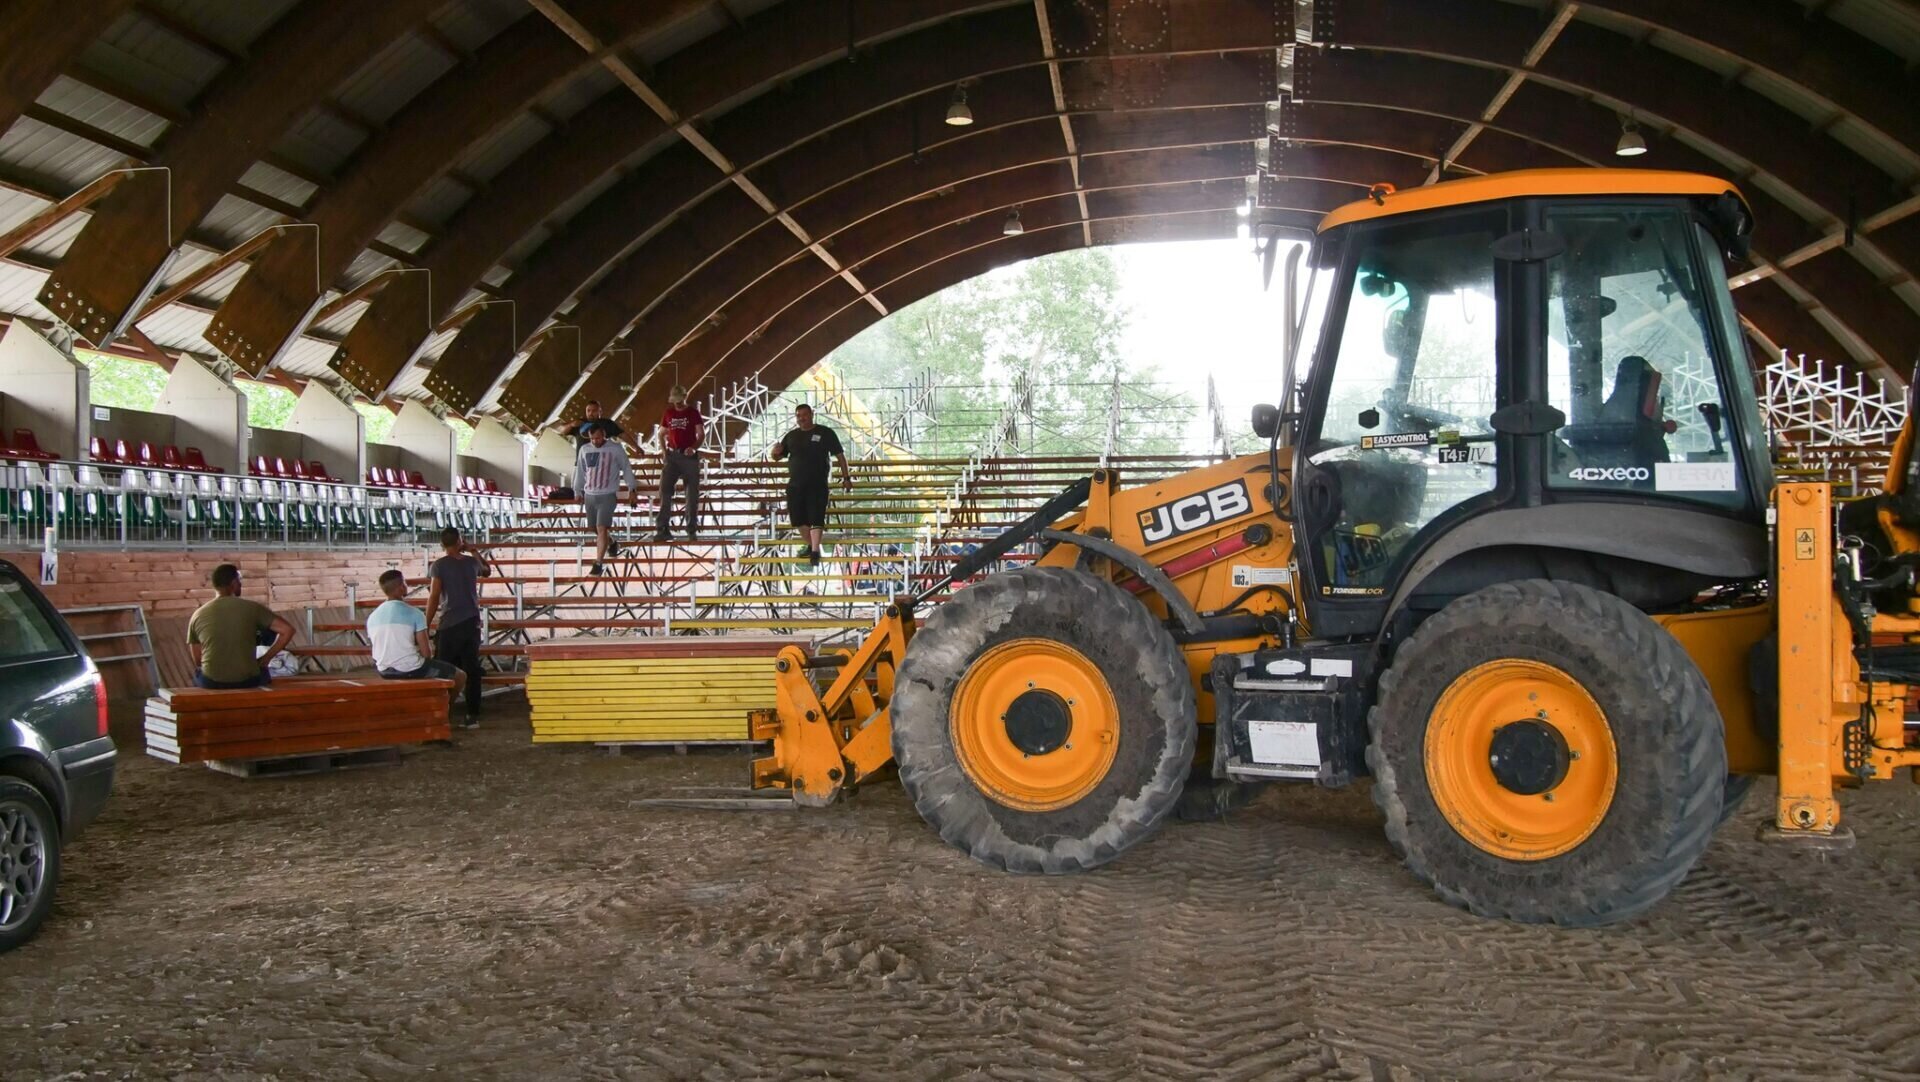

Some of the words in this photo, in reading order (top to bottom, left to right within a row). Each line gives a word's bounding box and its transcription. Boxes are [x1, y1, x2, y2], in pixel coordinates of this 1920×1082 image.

[1374, 434, 1428, 446] EASYCONTROL
[1568, 467, 1649, 481] 4CXeco
[1143, 483, 1249, 542] JCB
[45, 563, 55, 581] K
